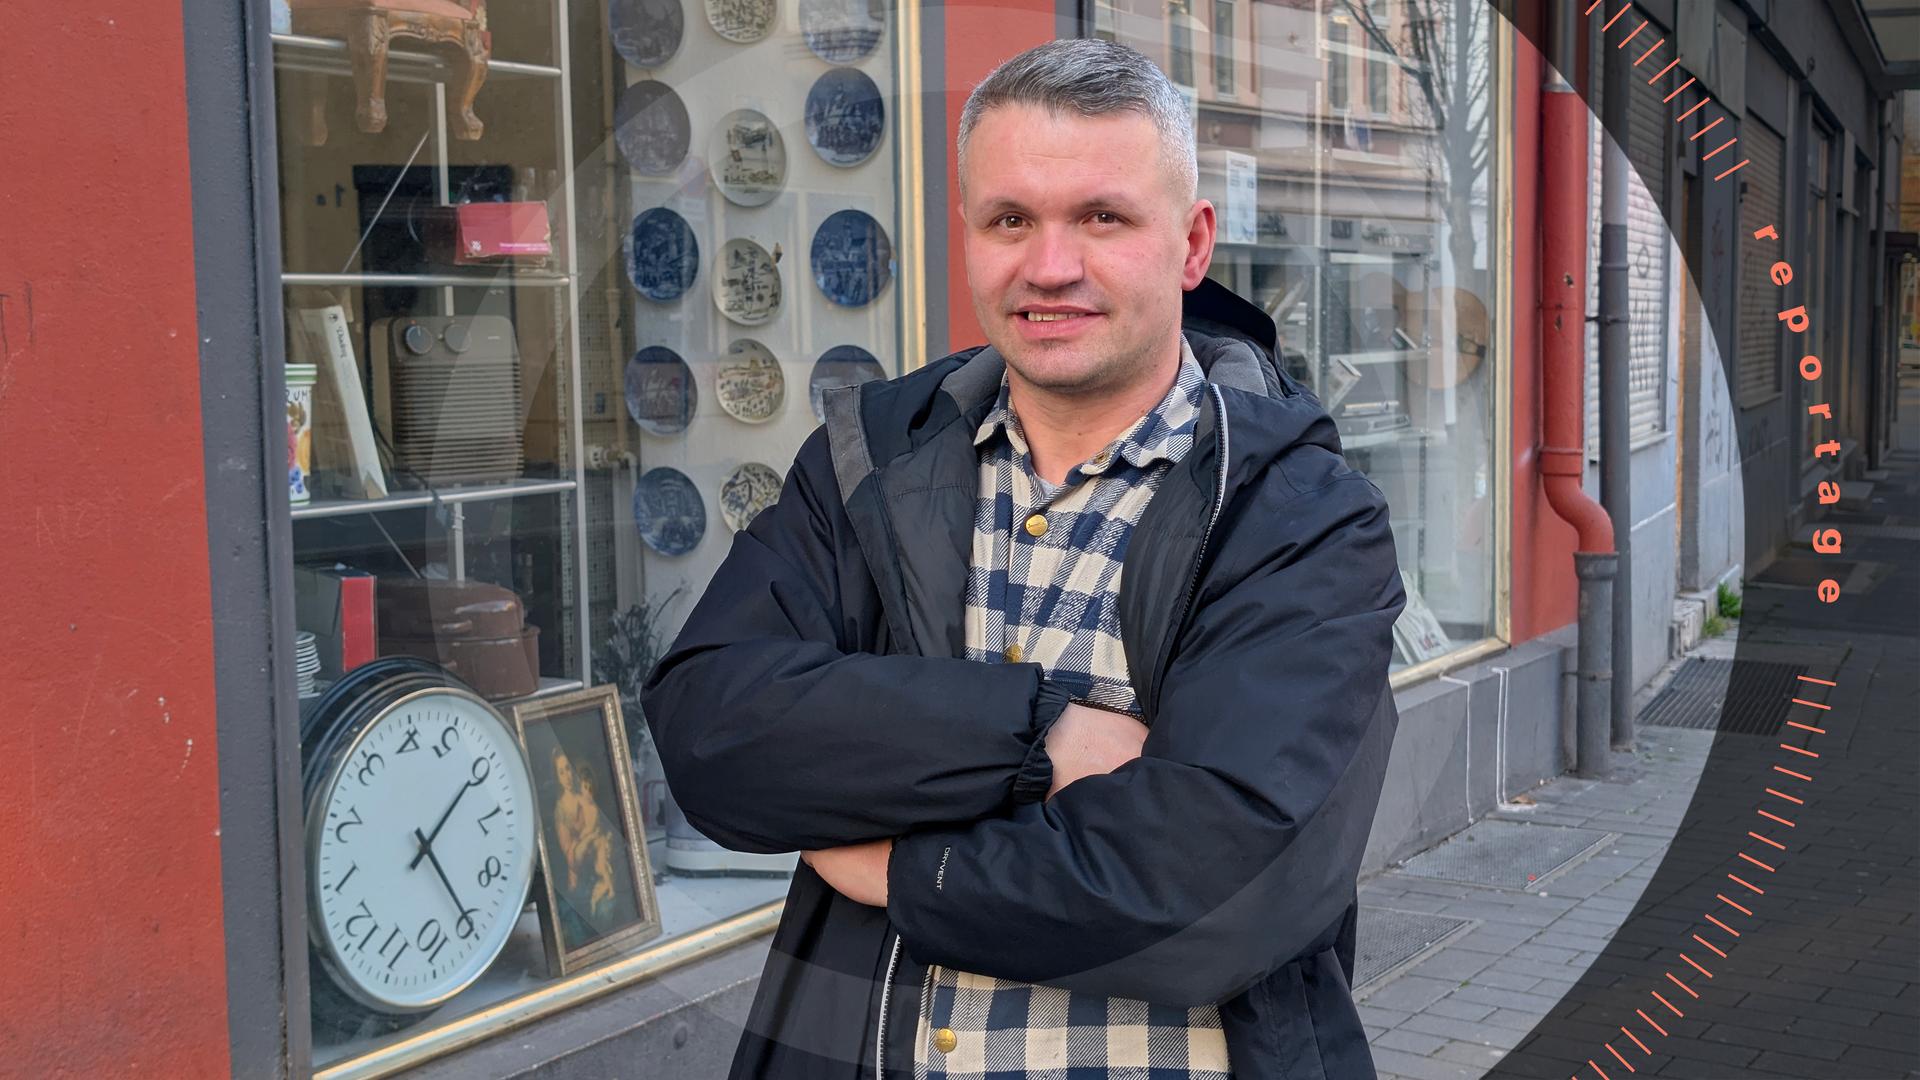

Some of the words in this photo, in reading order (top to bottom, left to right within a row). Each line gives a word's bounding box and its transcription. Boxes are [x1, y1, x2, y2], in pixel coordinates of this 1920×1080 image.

[396, 727, 421, 755] 4
[432, 726, 460, 759] 5
[358, 753, 385, 786] 3
[468, 757, 490, 787] 6
[336, 806, 363, 843] 2
[477, 806, 502, 836] 7
[335, 861, 360, 895] 1
[478, 856, 501, 888] 8
[936, 847, 951, 890] DRYVENT
[346, 900, 381, 952] 12
[417, 919, 452, 965] 10
[378, 923, 412, 971] 11
